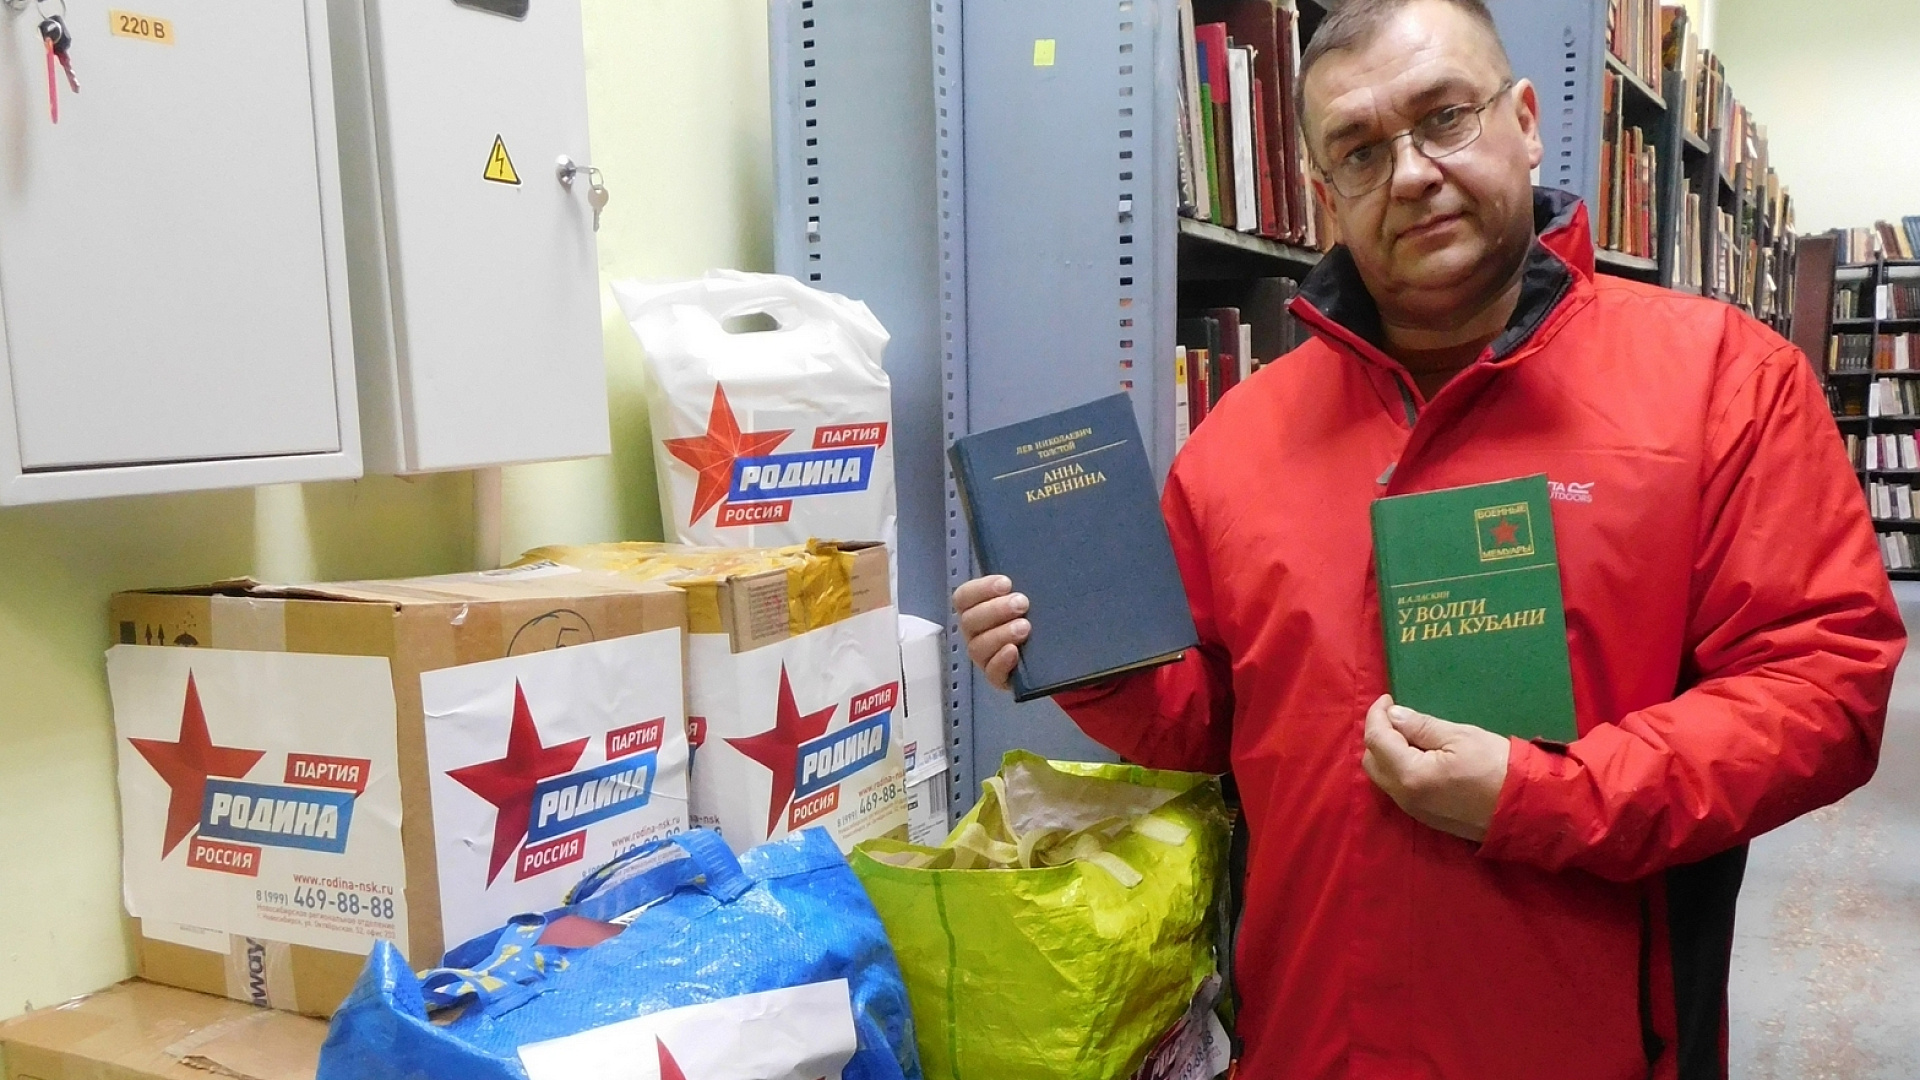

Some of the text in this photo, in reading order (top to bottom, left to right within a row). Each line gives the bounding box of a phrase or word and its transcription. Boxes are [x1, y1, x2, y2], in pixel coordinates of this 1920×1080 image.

[120, 15, 149, 36] 220
[821, 427, 880, 444] ПАРТИЯ
[1035, 427, 1092, 449] НИКОЛАЕВИЧ
[1037, 441, 1076, 459] ТОЛСТОЙ
[739, 457, 861, 491] РОДИНА
[1043, 462, 1084, 484] АННА
[1025, 470, 1107, 503] КАРЕНИНА
[725, 505, 783, 522] РОССИЯ
[1477, 504, 1528, 520] ВОЕННЫЕ
[1482, 543, 1533, 560] МЕМУАРЫ
[1398, 598, 1487, 625] У ВОЛГИ
[1400, 608, 1547, 643] И НА КУБАНИ
[854, 688, 892, 714] ПАРТИЯ
[611, 725, 658, 753] ПАРТИЯ
[803, 723, 883, 785] РОДИНА
[294, 760, 360, 783] ПАРТИЯ
[538, 765, 649, 828] РОДИНА
[793, 792, 835, 822] РОССИЯ
[209, 792, 340, 840] РОДИНА
[611, 817, 681, 848] www.rodina-nsk.ru
[194, 846, 254, 869] РОССИЯ
[523, 837, 581, 873] РОССИЯ
[293, 873, 393, 896] www.rodina-nsk.ru
[256, 886, 394, 919] 8 (999) 469-88-88
